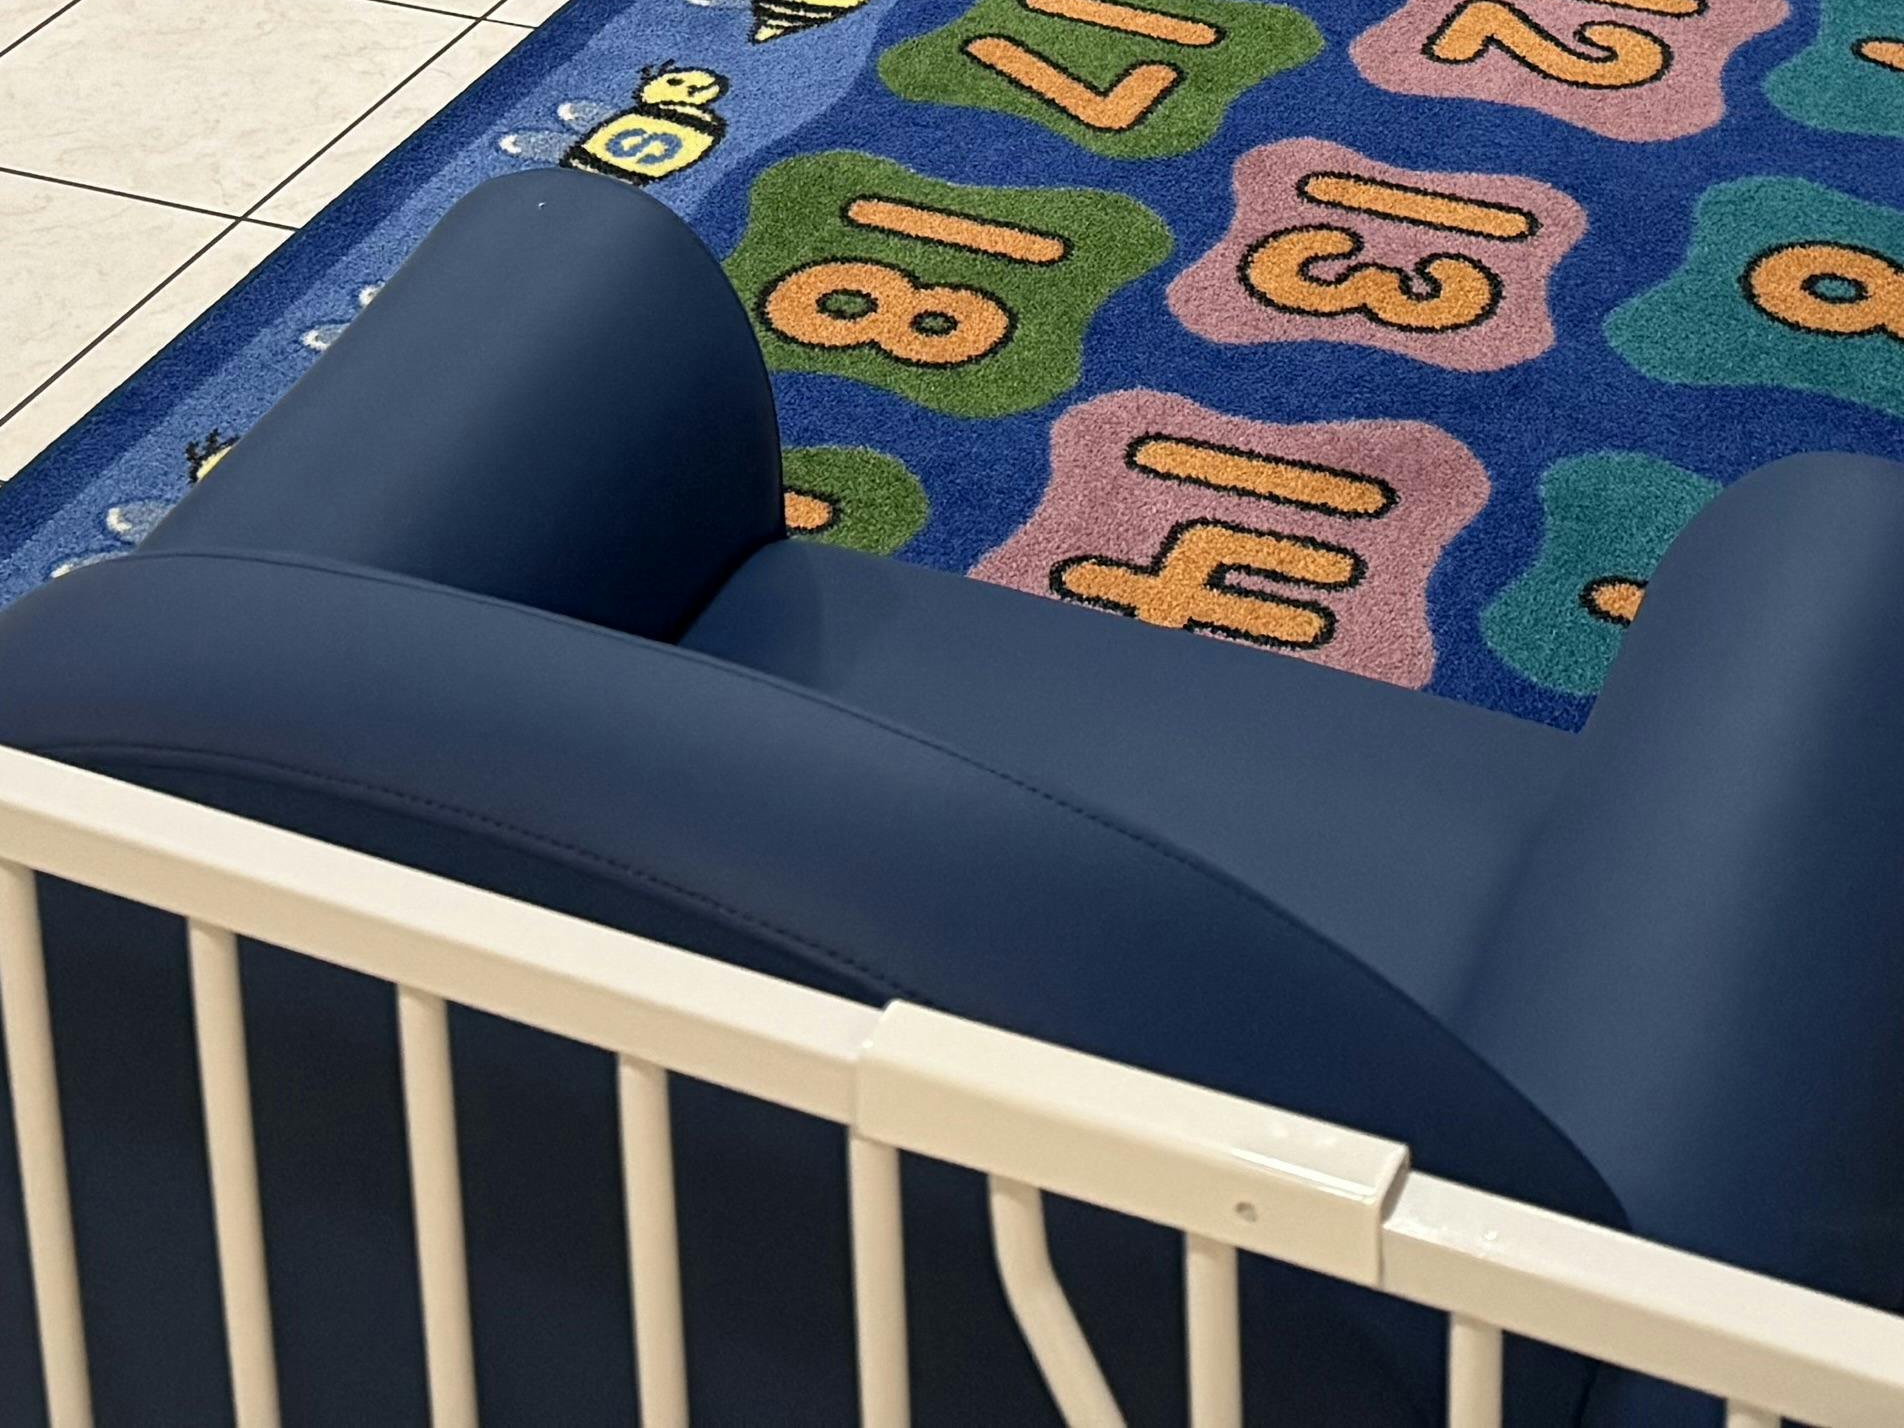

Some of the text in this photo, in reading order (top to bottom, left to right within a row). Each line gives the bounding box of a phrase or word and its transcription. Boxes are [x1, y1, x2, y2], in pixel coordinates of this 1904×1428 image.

[758, 194, 1074, 366] 18
[1237, 171, 1537, 334] 13
[1048, 431, 1398, 651] 14
